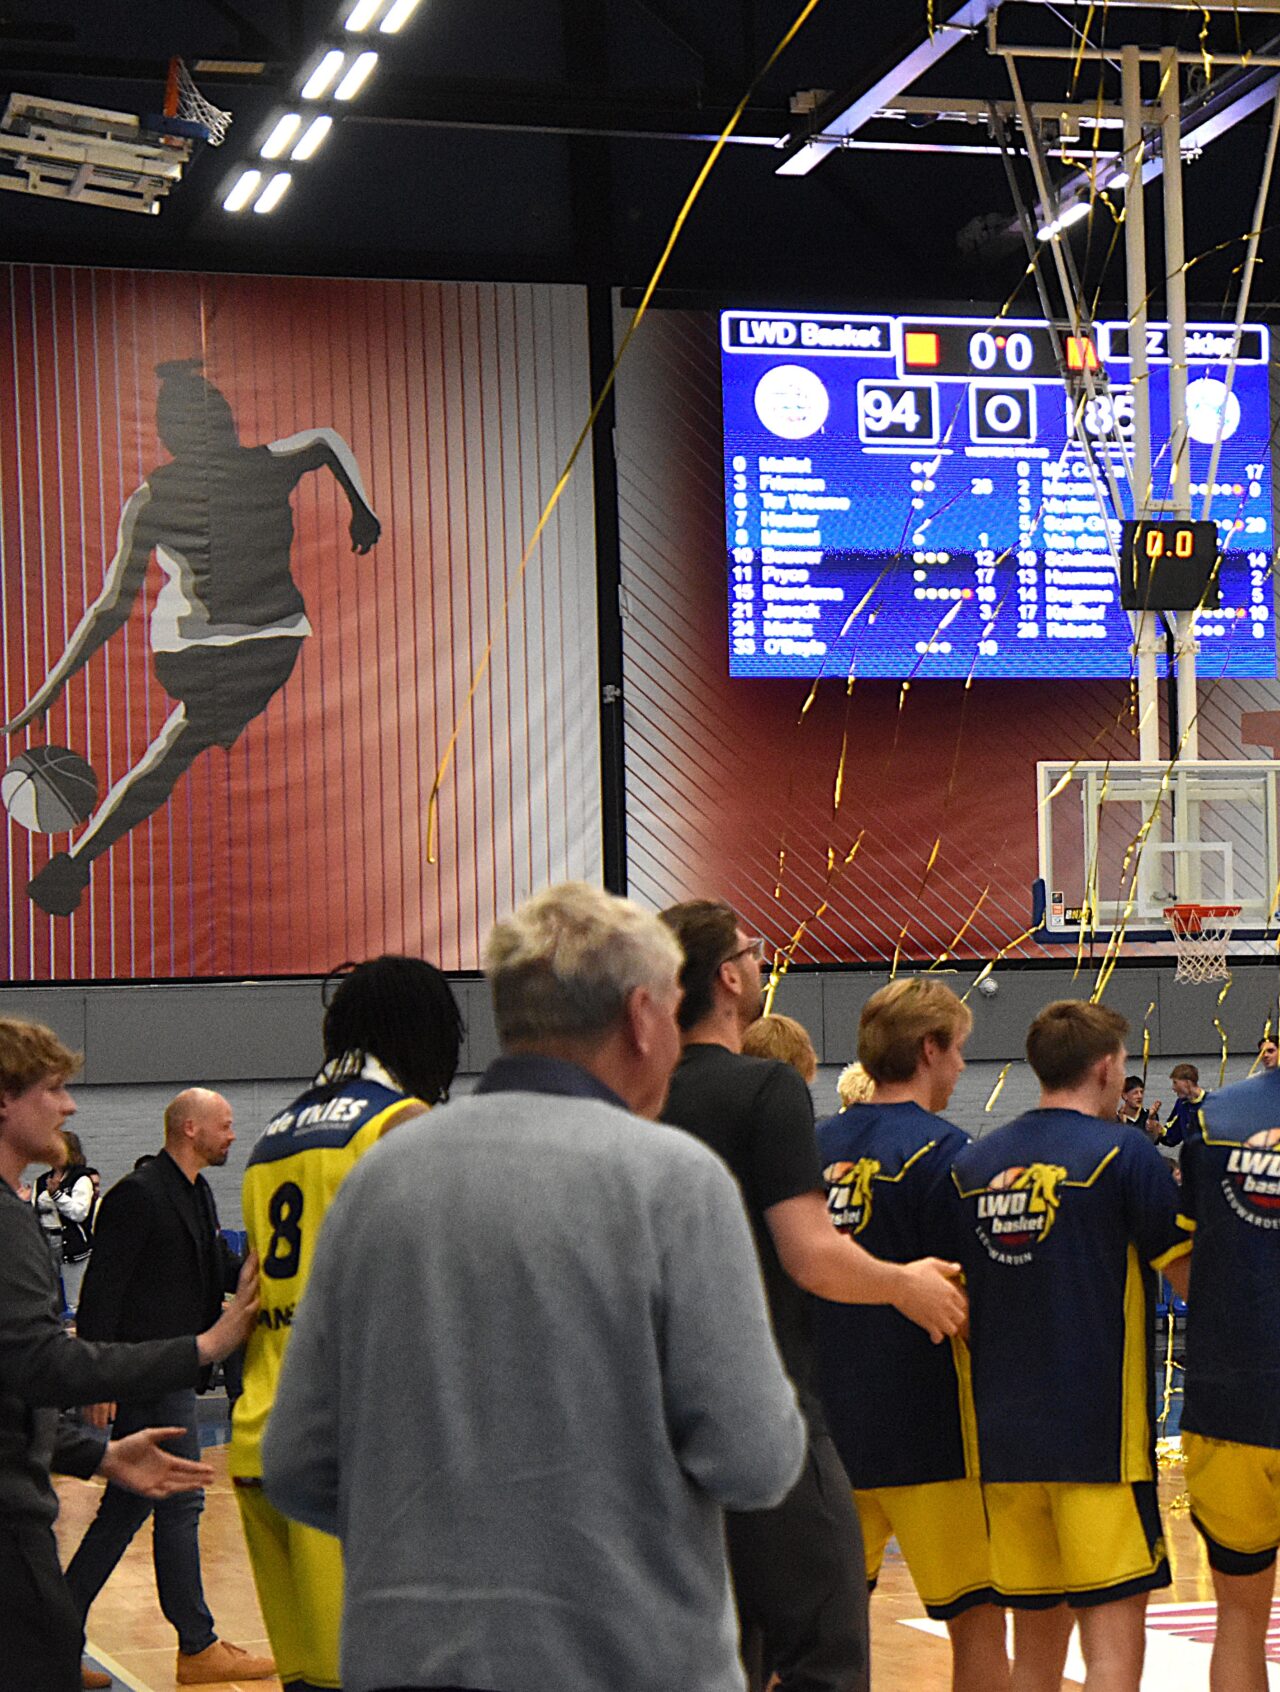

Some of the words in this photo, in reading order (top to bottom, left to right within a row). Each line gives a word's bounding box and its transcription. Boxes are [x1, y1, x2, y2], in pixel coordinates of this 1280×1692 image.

[740, 321, 797, 345] LWD
[801, 323, 881, 348] Basket
[864, 391, 920, 430] 94
[1246, 465, 1265, 480] 17
[734, 475, 747, 490] 3
[1018, 480, 1029, 495] 2
[1019, 497, 1031, 512] 3
[735, 511, 747, 526] 7
[978, 533, 988, 548] 1
[1145, 530, 1193, 558] 0.0
[975, 551, 995, 567] 12
[1248, 553, 1267, 568] 14
[732, 566, 752, 581] 11
[976, 569, 995, 584] 17
[1017, 569, 1038, 584] 13
[1252, 571, 1263, 586] 2
[732, 584, 754, 600] 15
[1018, 587, 1038, 602] 14
[1252, 588, 1263, 603] 5
[732, 602, 753, 618] 21
[979, 604, 991, 619] 3
[1018, 605, 1037, 620] 17
[977, 1192, 1028, 1219] LWD
[263, 1180, 304, 1279] 8
[991, 1214, 1045, 1234] basket
